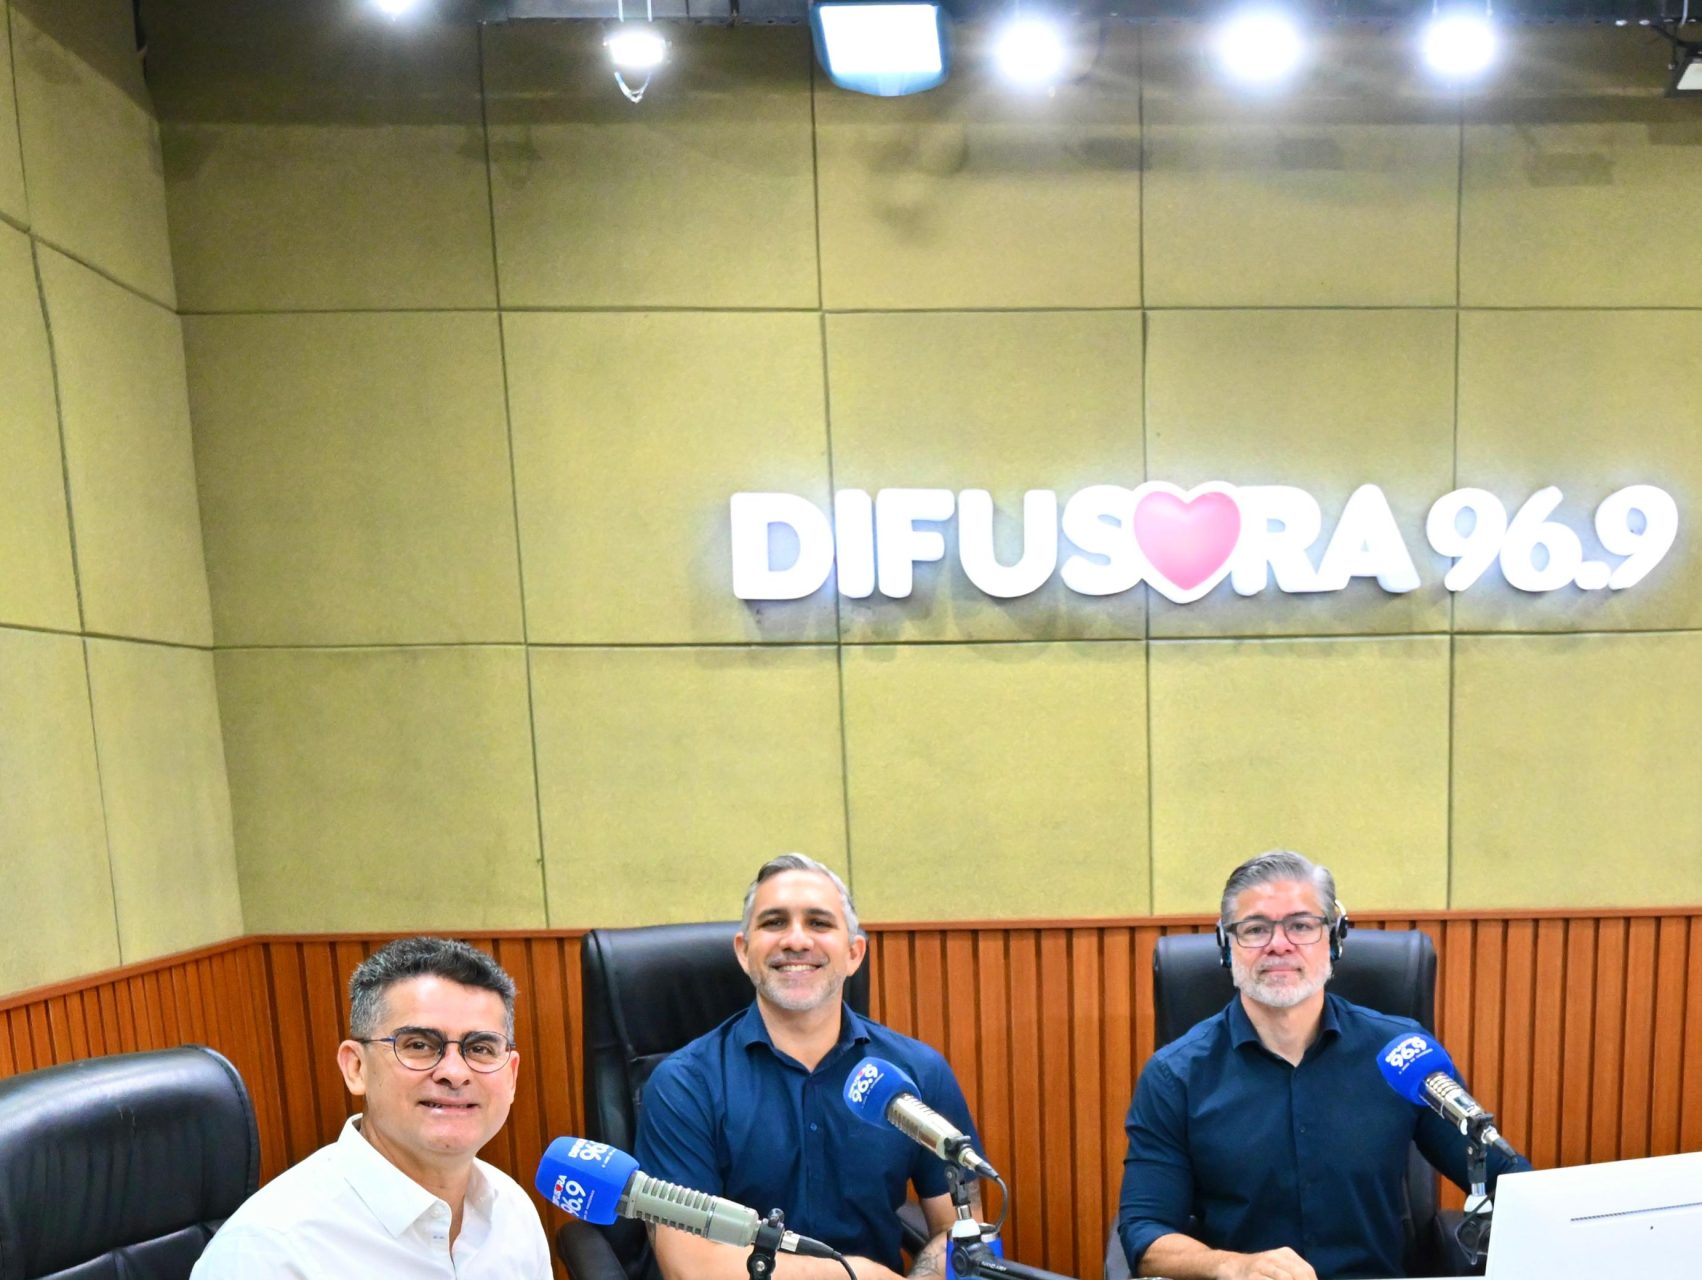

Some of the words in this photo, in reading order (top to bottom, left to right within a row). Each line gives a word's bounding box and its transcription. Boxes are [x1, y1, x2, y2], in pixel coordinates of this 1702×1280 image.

[1427, 483, 1680, 593] 96.9
[1390, 1038, 1427, 1068] 96.9
[852, 1065, 878, 1102] 96.9
[560, 1180, 587, 1217] 96.9
